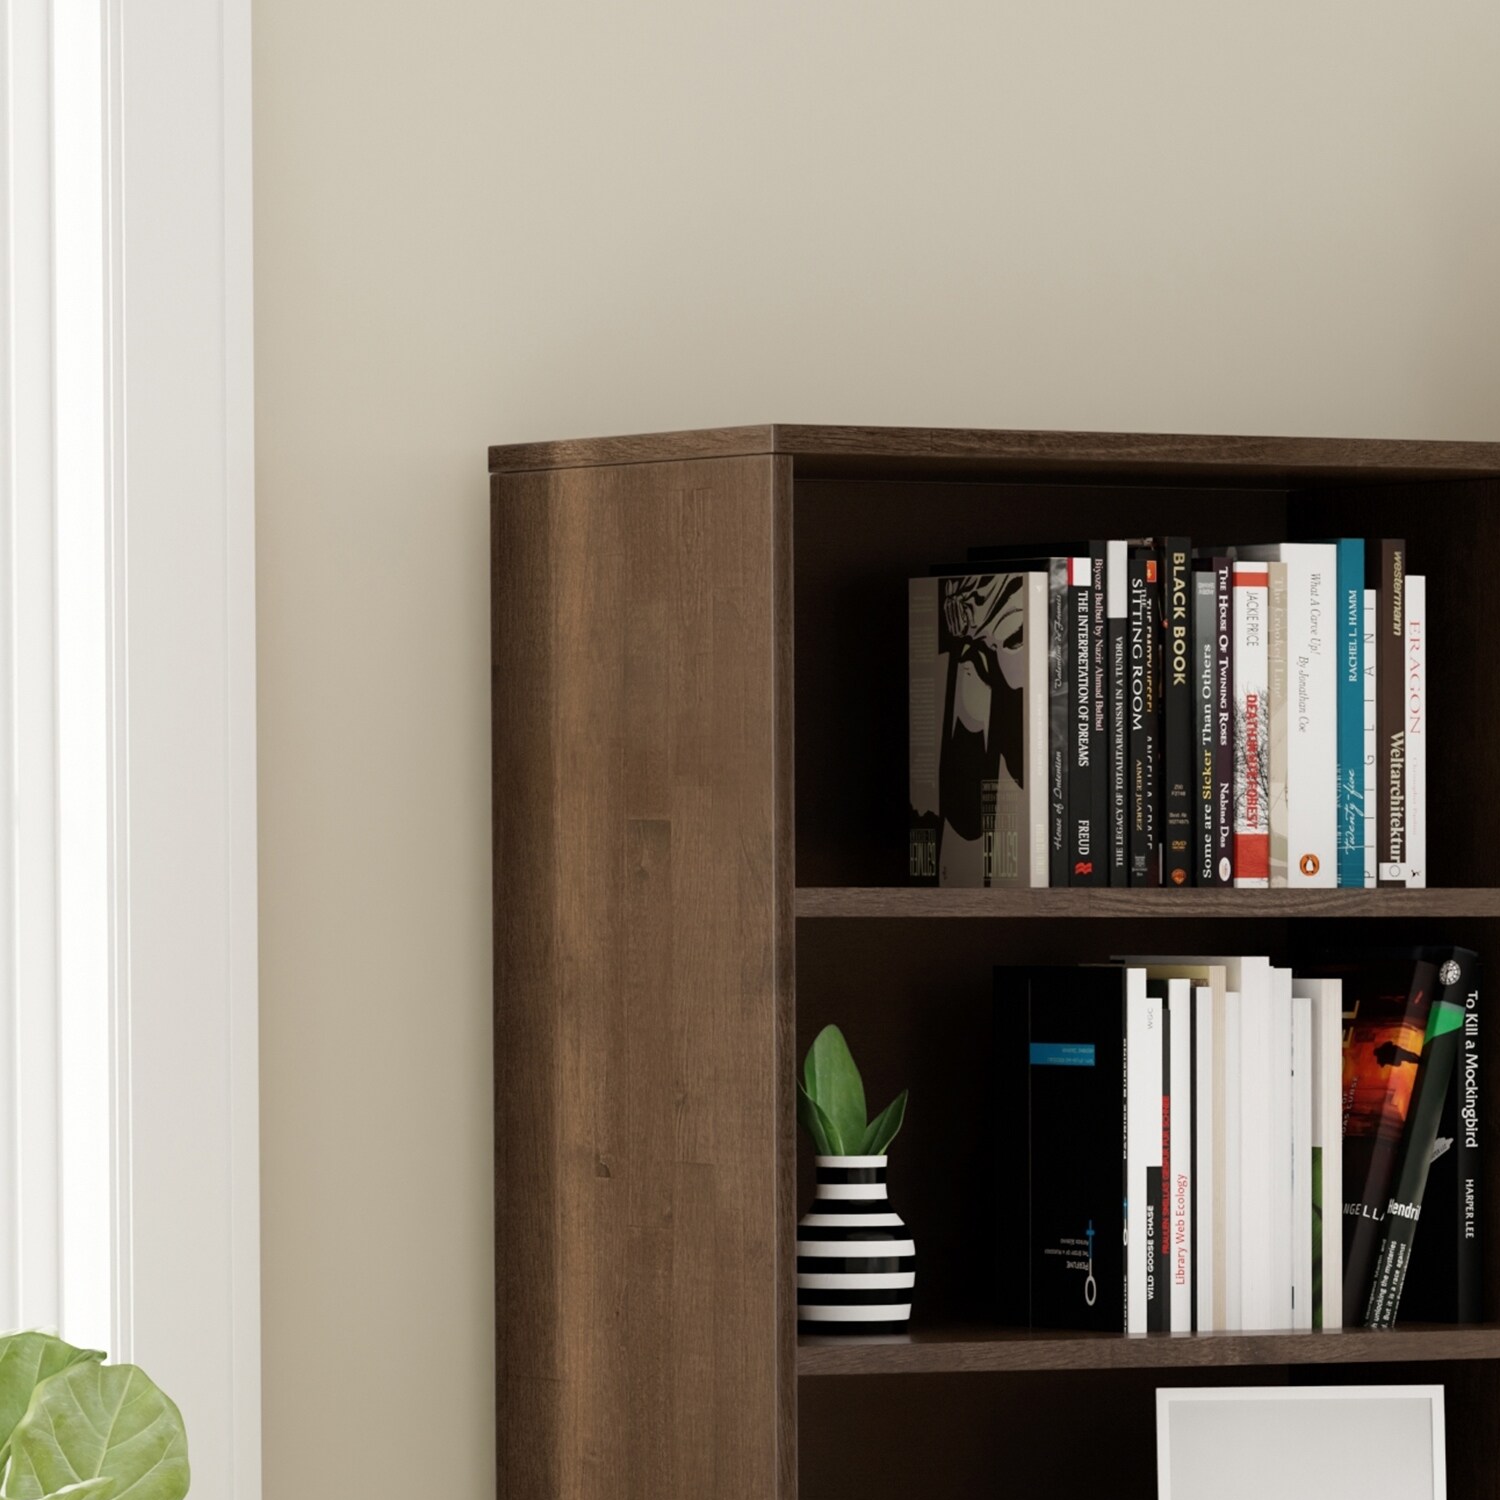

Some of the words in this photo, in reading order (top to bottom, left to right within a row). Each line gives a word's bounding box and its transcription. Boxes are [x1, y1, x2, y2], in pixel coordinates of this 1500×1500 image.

[1173, 552, 1187, 620] BLACK
[1218, 566, 1228, 591] THE
[1309, 572, 1320, 597] What
[1393, 552, 1402, 636] westermann
[1077, 590, 1089, 613] THE
[1132, 578, 1143, 660] SITTING
[1218, 595, 1228, 631] HOUSE
[1246, 591, 1259, 621] JACKIE
[1309, 598, 1320, 607] A
[1348, 590, 1357, 625] HAMM
[1093, 626, 1104, 637] by
[1246, 622, 1259, 647] PRICE
[1309, 608, 1320, 636] Carve
[1077, 615, 1089, 704] INTERPRETATION
[1115, 636, 1124, 677] TUNDRA
[1173, 626, 1187, 686] BOOK
[1218, 635, 1228, 654] OF
[1297, 655, 1309, 669] By
[1308, 637, 1320, 655] Up!
[1348, 639, 1357, 682] RACHEL
[1115, 677, 1124, 686] A
[1202, 644, 1213, 699] Others
[1218, 656, 1228, 709] TWINING
[1409, 620, 1421, 734] ERAGON
[1115, 688, 1124, 700] IN
[1132, 665, 1143, 731] ROOM
[1297, 669, 1309, 714] Jonathan
[1077, 706, 1089, 720] OF
[1202, 704, 1213, 745] Than
[1218, 712, 1228, 746] ROSES
[1246, 694, 1258, 736] DEATH
[1297, 716, 1309, 733] Coe
[1077, 722, 1089, 767] DREAMS
[1115, 701, 1124, 790] TOTALITARIANISM
[1202, 749, 1213, 800] Sicker
[1115, 792, 1124, 806] OF
[1389, 731, 1404, 862] Weltarchitektur
[1115, 807, 1124, 845] LEGACY
[1204, 804, 1213, 829] are
[1077, 820, 1089, 855] FREUD
[1115, 846, 1124, 867] THE
[1202, 834, 1213, 879] Some
[1465, 990, 1479, 1009] To
[1465, 1012, 1479, 1036] Kill
[1465, 1040, 1476, 1050] a
[1461, 1053, 1479, 1148] Mockingbird
[1175, 1174, 1188, 1216] Ecology
[1465, 1178, 1475, 1219] HARPER
[1175, 1219, 1186, 1244] Web
[1465, 1221, 1475, 1239] LEE
[1175, 1247, 1188, 1285] Library
[1384, 1240, 1398, 1273] mysteries
[1380, 1273, 1390, 1288] the
